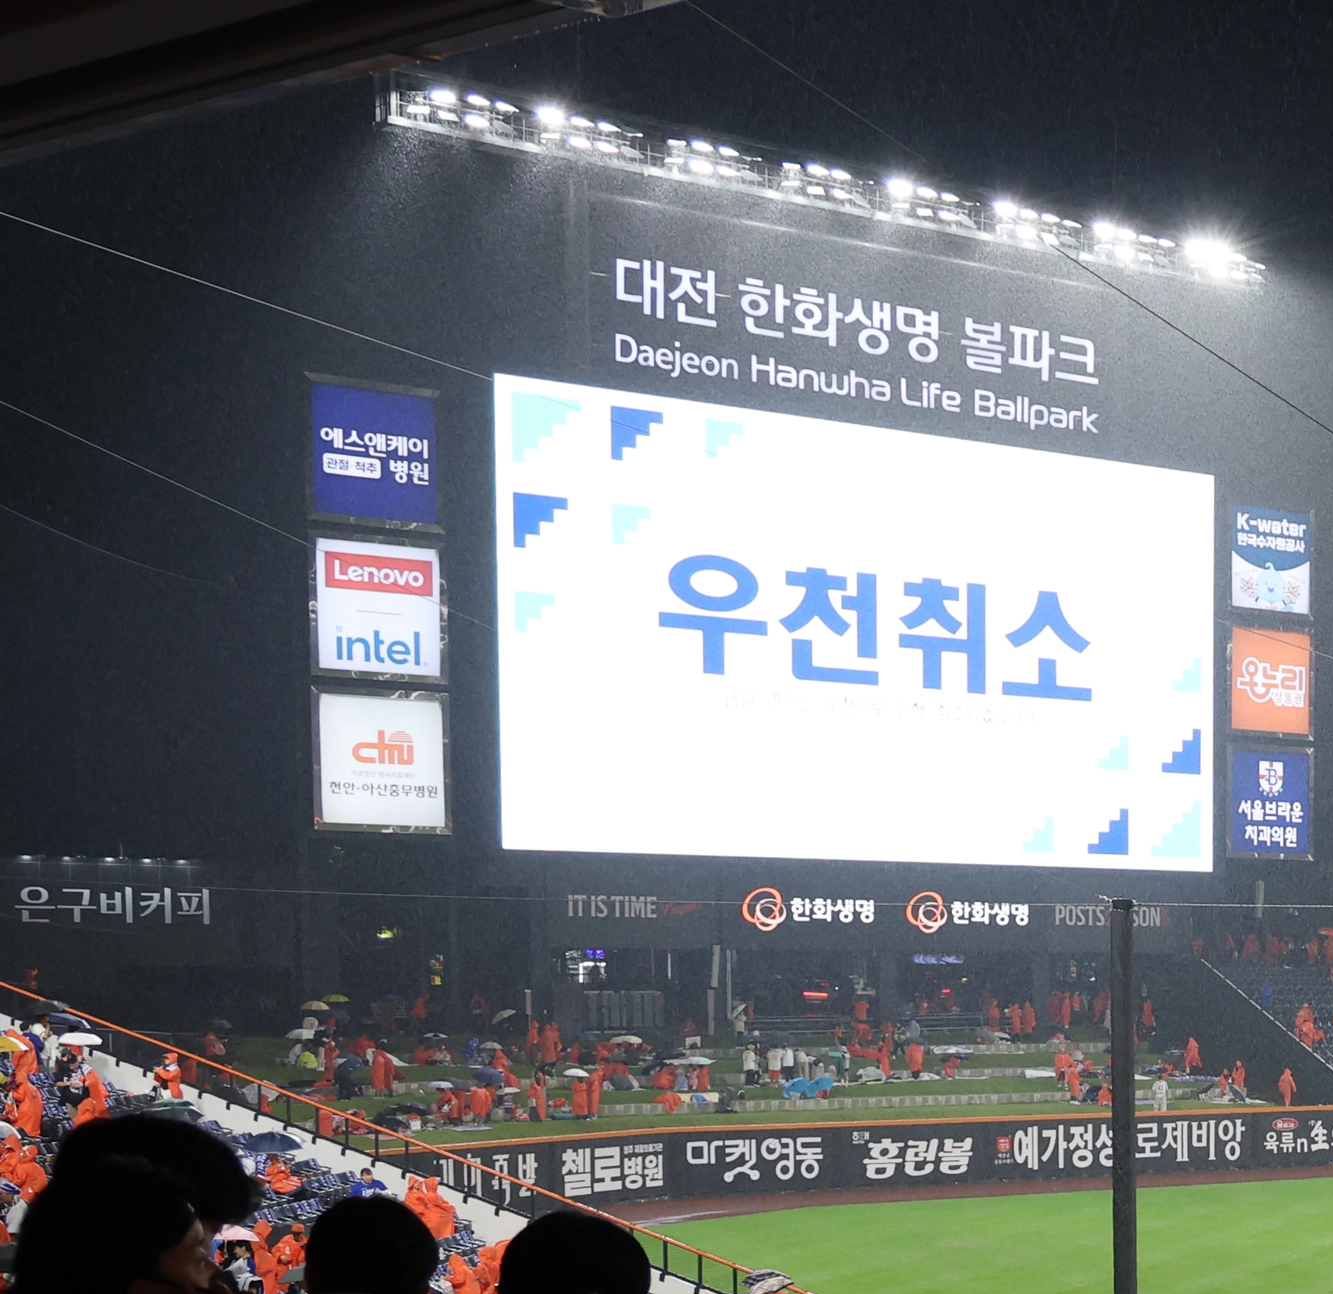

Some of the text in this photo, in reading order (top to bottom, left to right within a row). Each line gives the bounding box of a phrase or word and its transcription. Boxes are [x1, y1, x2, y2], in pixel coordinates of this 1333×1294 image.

[614, 258, 1099, 385] 대전 한화생명 볼파크
[614, 333, 1100, 433] Daejeon Hanwha Life Ballpark
[320, 427, 429, 459] 에스앤케이
[389, 459, 430, 486] 병원
[1236, 512, 1307, 538] K-water
[1236, 532, 1306, 554] 한국수자원공사
[333, 558, 425, 588] Lenovo
[658, 554, 1092, 702] 우천취소
[335, 625, 421, 666] intel
[329, 781, 438, 799] 천안·아산충무병원
[1238, 799, 1304, 824] 서울브라운
[1244, 825, 1298, 848] 치과의원
[14, 886, 211, 926] 은구비커피
[567, 894, 589, 918] IT
[590, 894, 608, 918] IS
[610, 894, 658, 919] TIME
[790, 897, 876, 924] 한화생명
[950, 900, 1030, 927] 한화생명
[1055, 905, 1162, 928] POSTSSON
[1135, 1119, 1246, 1162] 로제비앙
[686, 1136, 824, 1183] 마켓영동
[862, 1136, 974, 1180] 홈런볼
